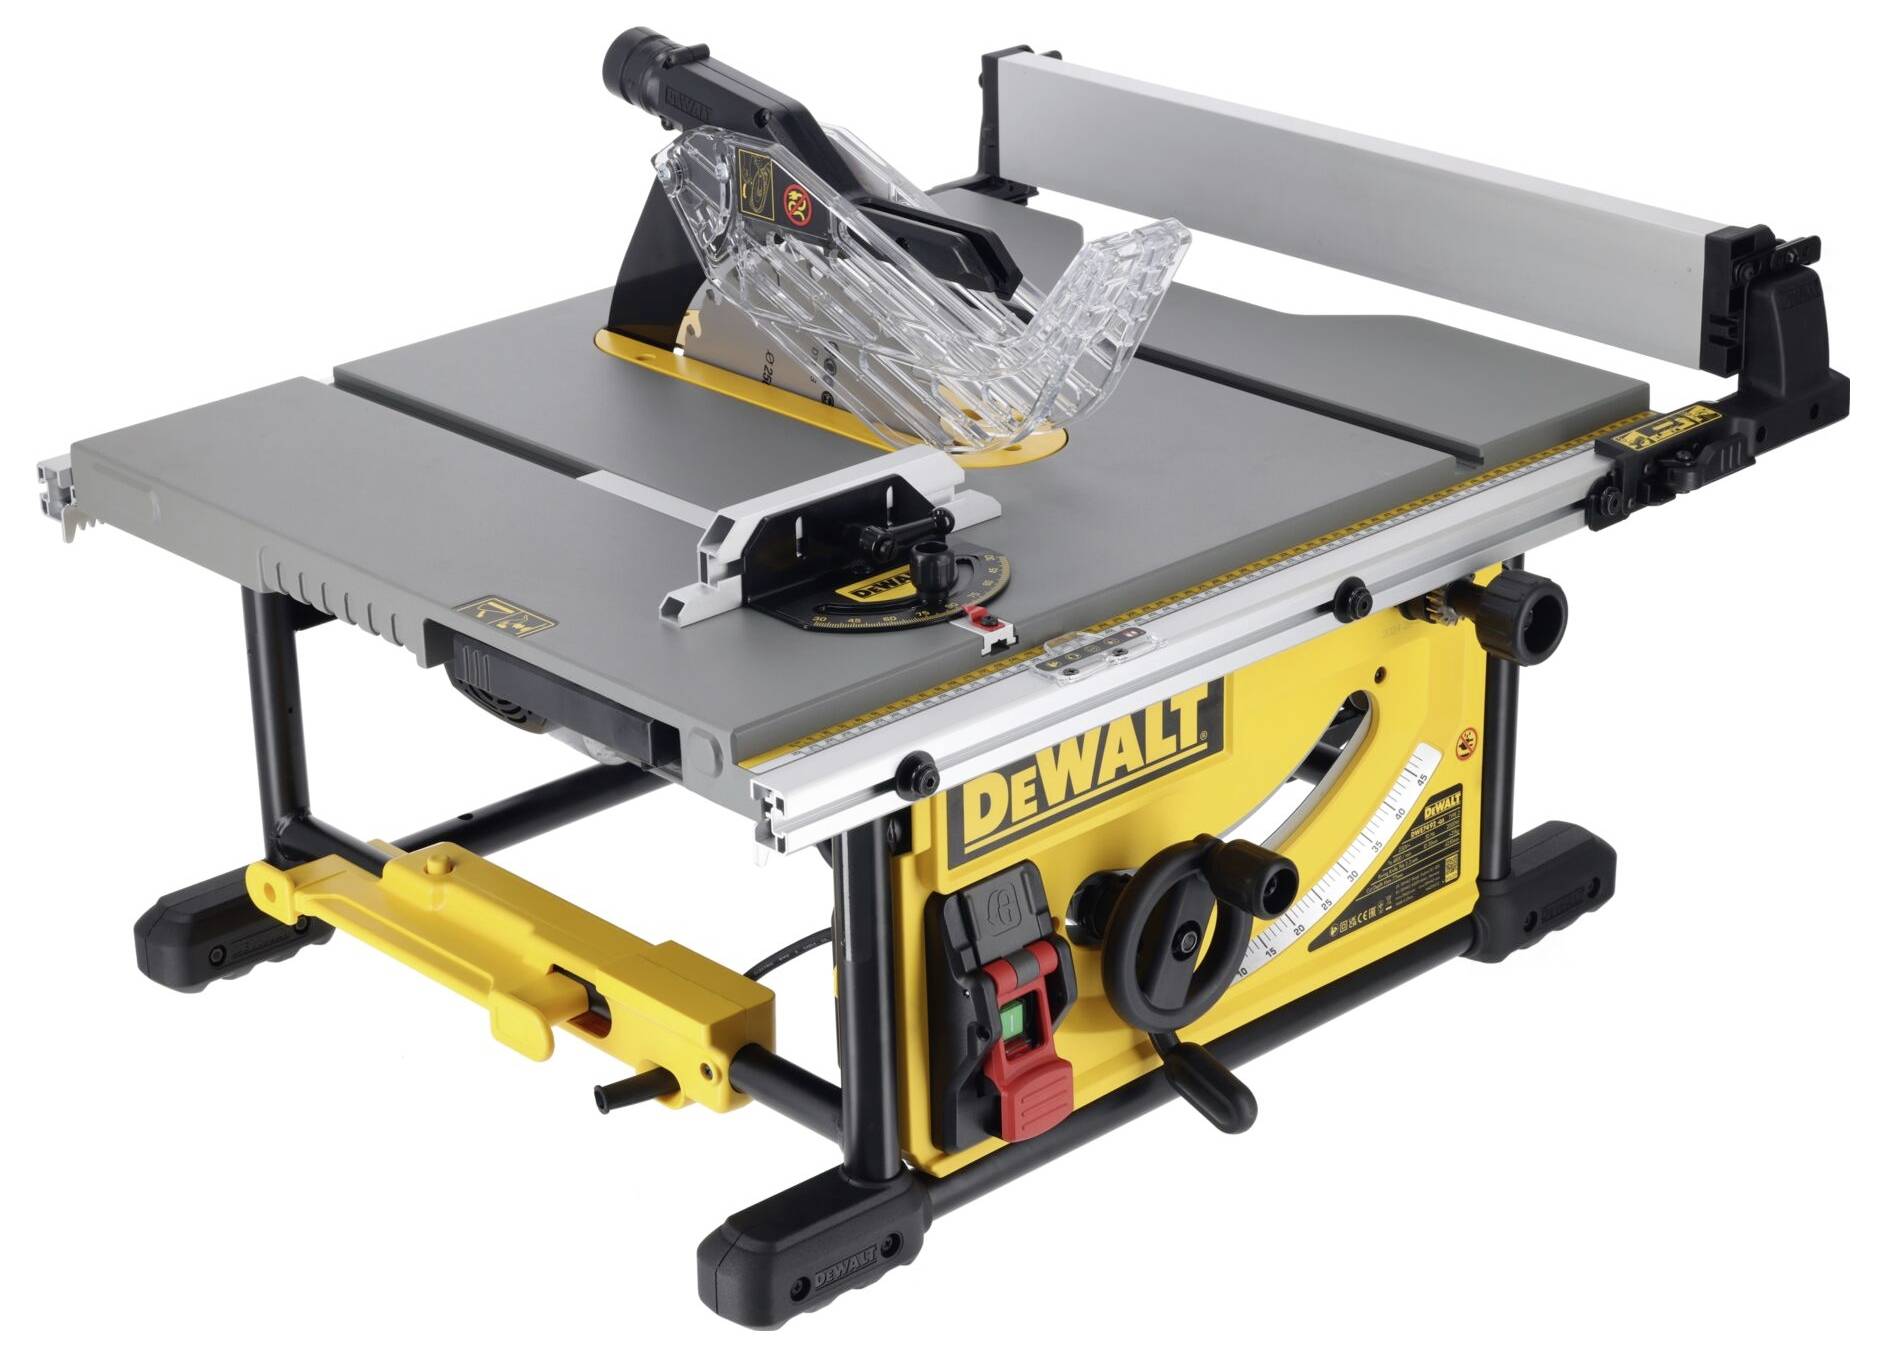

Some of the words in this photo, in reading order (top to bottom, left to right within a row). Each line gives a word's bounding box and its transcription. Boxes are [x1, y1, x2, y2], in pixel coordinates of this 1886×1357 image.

[853, 574, 911, 598] DEWA
[963, 682, 1208, 844] DEWALT
[1417, 774, 1428, 786] 45
[1424, 793, 1461, 819] DEWALT
[1395, 808, 1406, 820] 40
[1371, 841, 1383, 852] 35
[1347, 870, 1359, 882] 30
[1321, 899, 1333, 911] 25
[1293, 924, 1305, 936] 20
[1265, 947, 1277, 957] 15
[815, 1247, 877, 1288] DEWALT
